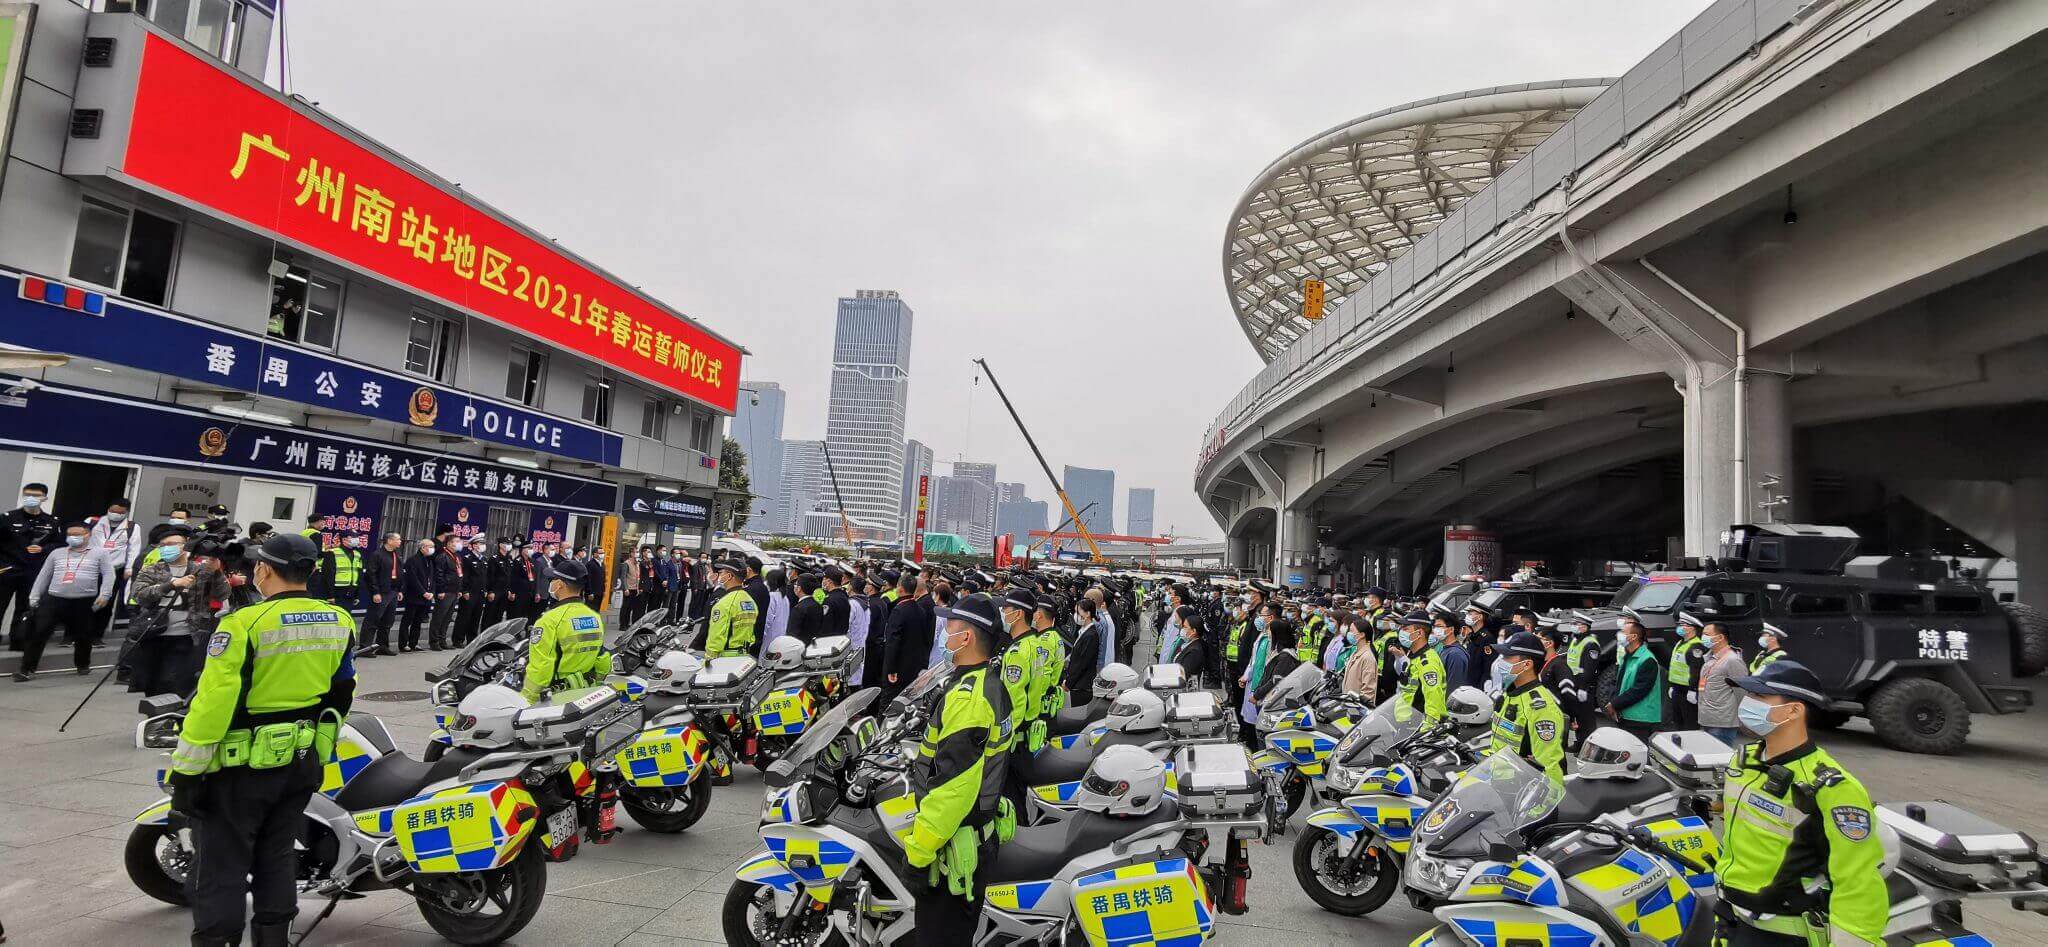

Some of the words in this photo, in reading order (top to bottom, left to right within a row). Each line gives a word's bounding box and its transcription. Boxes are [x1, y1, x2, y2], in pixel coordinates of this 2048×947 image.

[230, 131, 722, 390] 广州南站地区2021年春运誓师仪式
[206, 342, 383, 408] 番禺公安
[462, 406, 562, 448] POLICE
[250, 435, 549, 498] 广州南站核心区治安勤务中队
[1918, 629, 1968, 649] 特警
[1918, 648, 1969, 660] POLICE
[625, 742, 672, 759] 番禺铁骑
[406, 802, 474, 829] 番禺铁骑
[1661, 836, 1703, 852] 铁骑
[987, 889, 1015, 898] CF650J-2
[1622, 869, 1663, 897] CFMOTO
[1091, 885, 1174, 915] 番禺铁骑
